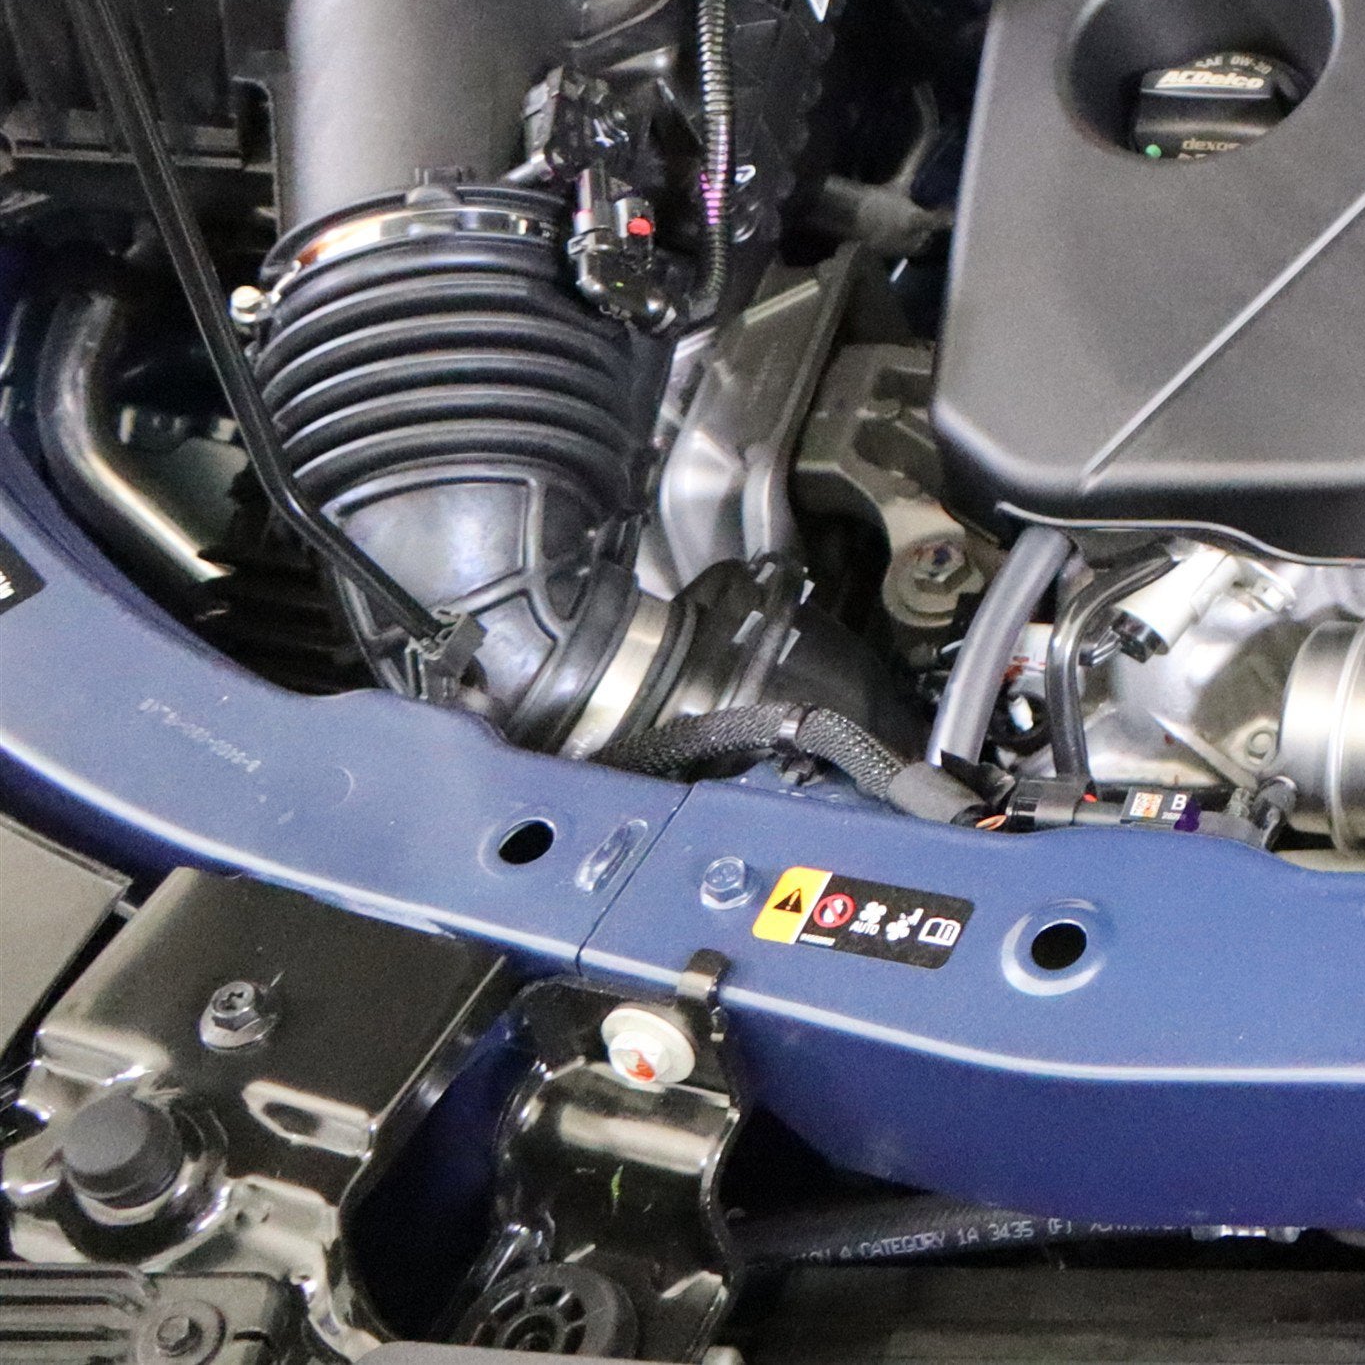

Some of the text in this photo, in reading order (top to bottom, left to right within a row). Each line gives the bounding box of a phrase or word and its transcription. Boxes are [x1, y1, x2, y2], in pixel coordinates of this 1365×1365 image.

[1154, 69, 1266, 89] ACDelco
[1171, 794, 1187, 811] B
[849, 920, 880, 936] AUTO
[861, 1231, 946, 1259] CATEGORY
[957, 1228, 980, 1246] 1A
[988, 1220, 1035, 1242] 3435
